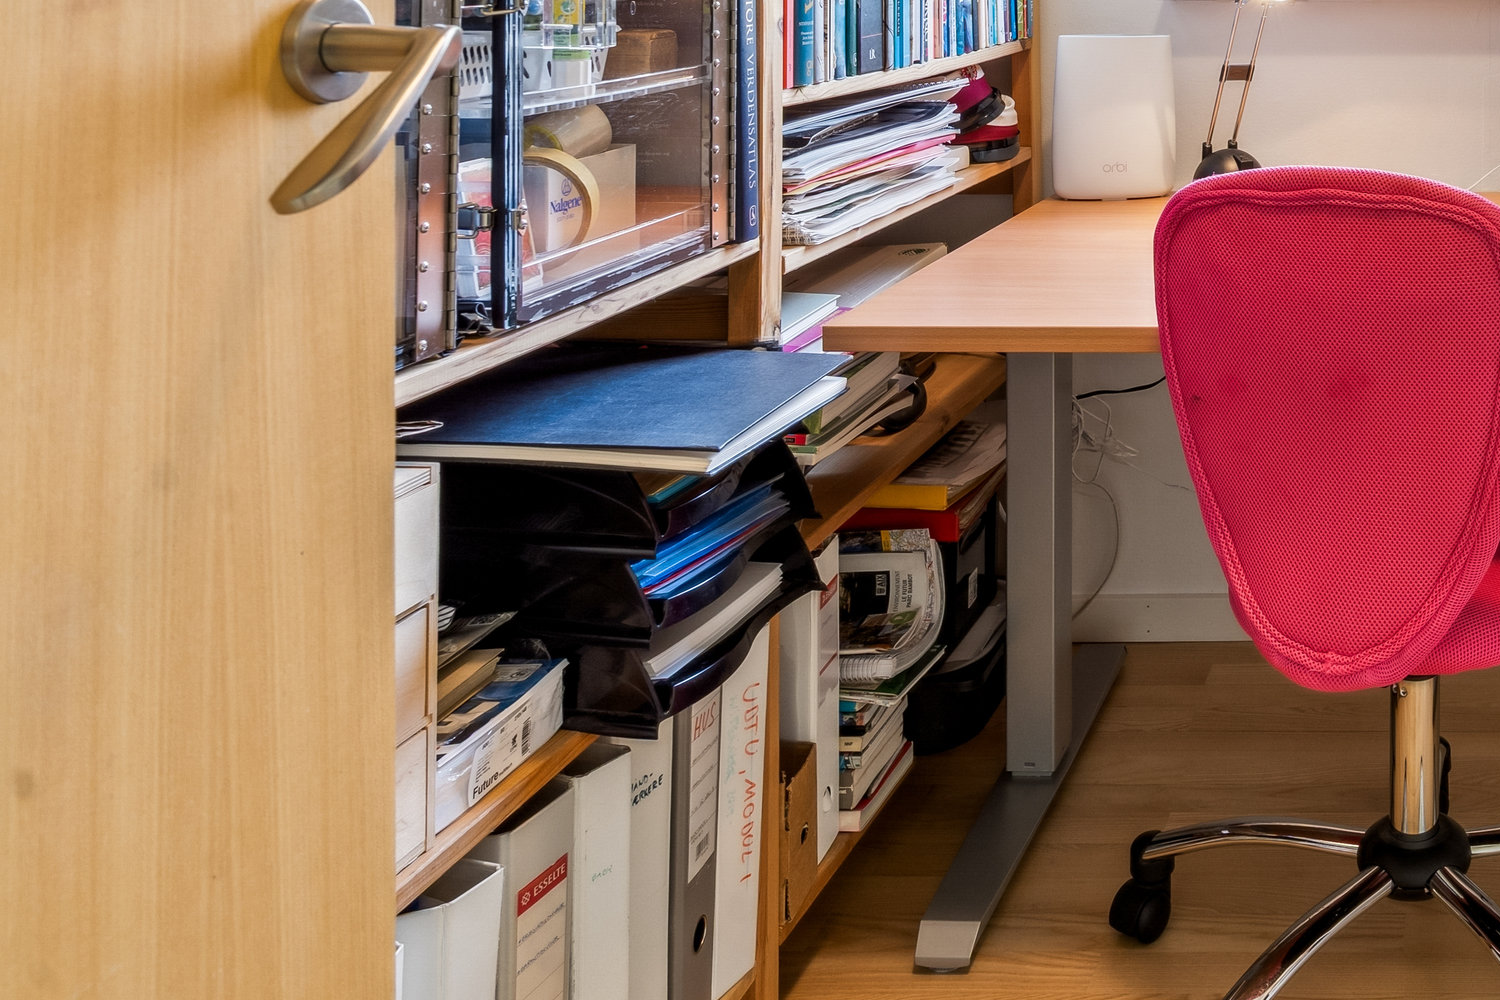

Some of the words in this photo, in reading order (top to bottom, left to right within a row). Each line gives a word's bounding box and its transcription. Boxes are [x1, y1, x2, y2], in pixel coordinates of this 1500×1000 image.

[746, 53, 756, 189] VERDENSATLAS
[1102, 160, 1128, 174] orbi
[550, 196, 583, 216] Nalgene
[877, 575, 886, 587] AIX
[693, 701, 717, 742] HUS
[472, 771, 500, 800] Future
[631, 773, 664, 807] ÆRKERE
[740, 778, 757, 864] MODUL
[533, 862, 567, 898] ESSELTE
